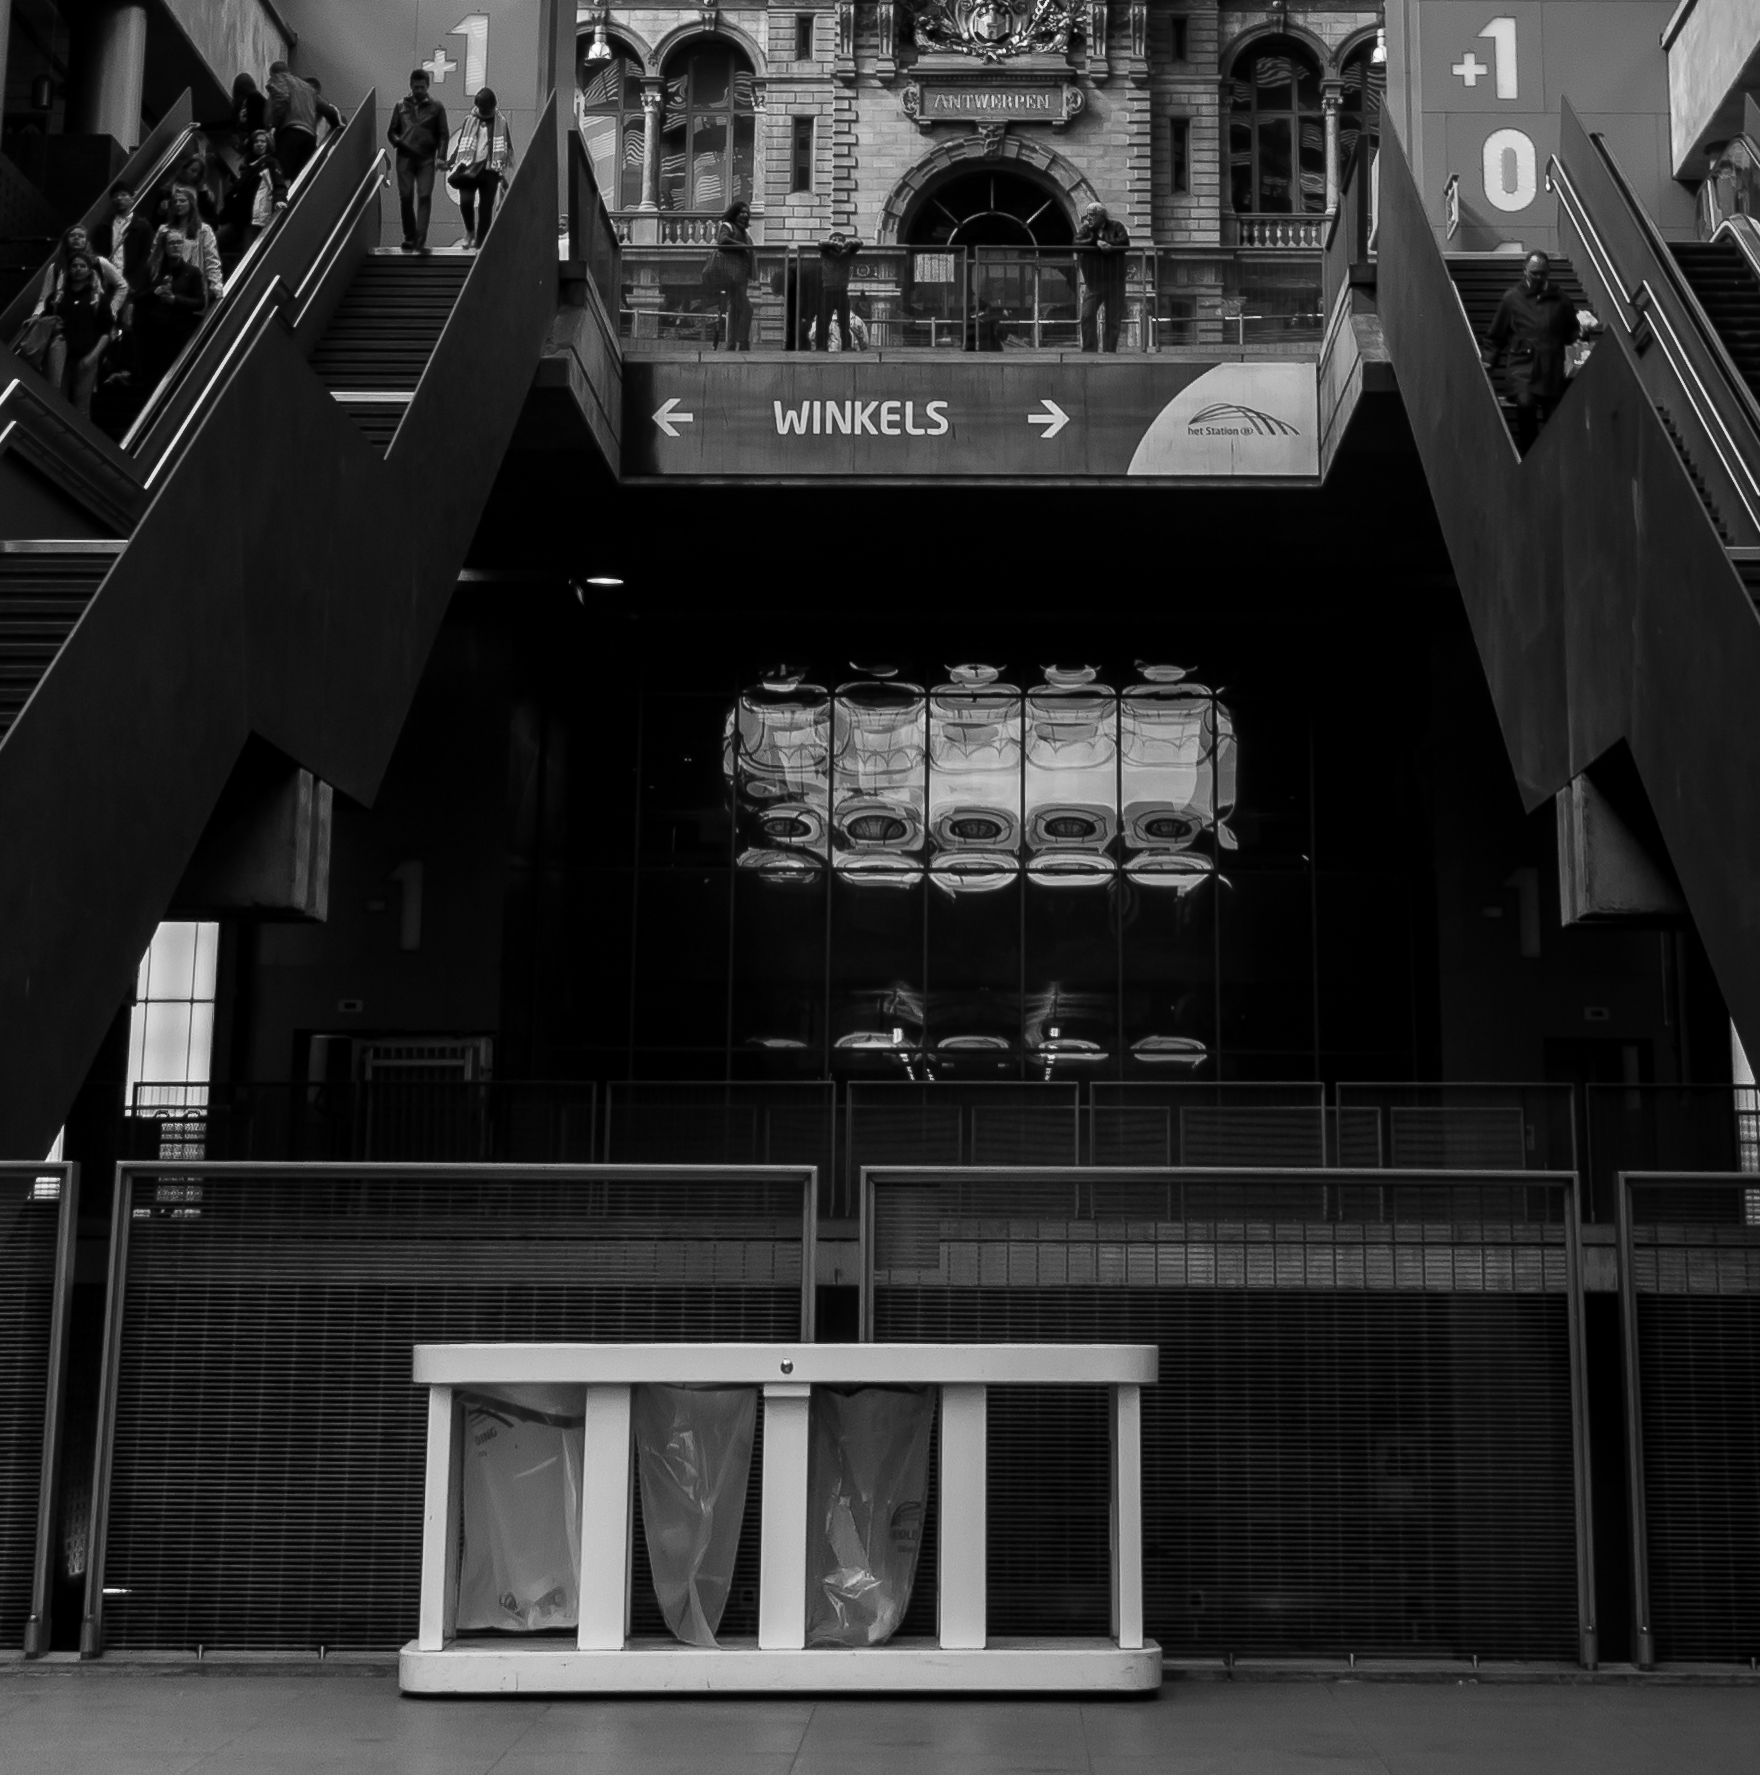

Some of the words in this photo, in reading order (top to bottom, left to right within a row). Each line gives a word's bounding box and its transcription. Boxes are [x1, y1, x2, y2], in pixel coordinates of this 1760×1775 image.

[422, 13, 490, 97] +1
[1452, 16, 1518, 100] +1
[934, 93, 1050, 109] ANTWERPEN
[1482, 128, 1538, 212] 0
[773, 400, 949, 436] WINKELS
[1187, 427, 1204, 436] het
[1205, 426, 1239, 436] Station
[364, 859, 424, 951] -1
[1481, 866, 1541, 958] -1
